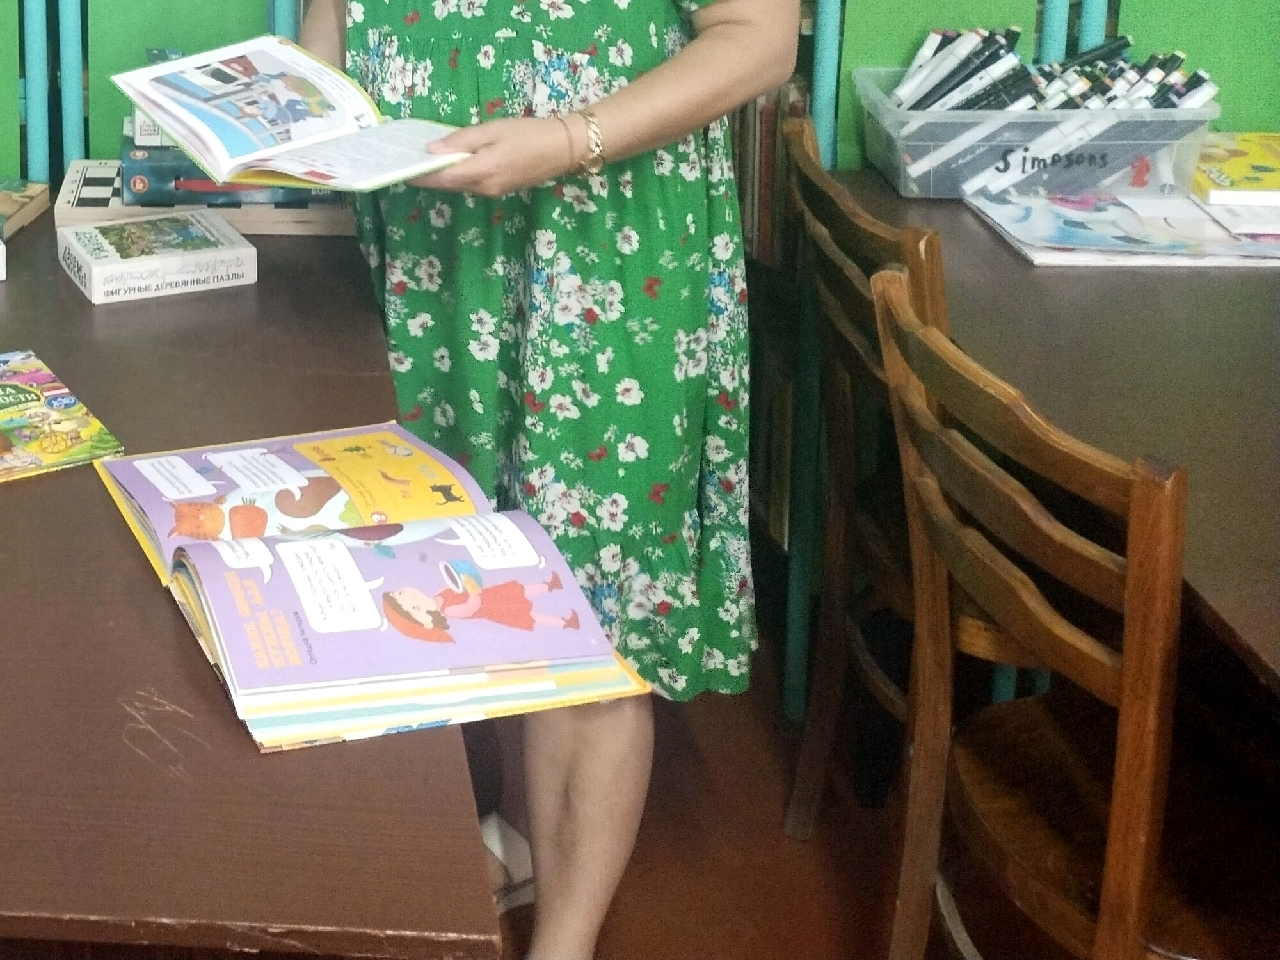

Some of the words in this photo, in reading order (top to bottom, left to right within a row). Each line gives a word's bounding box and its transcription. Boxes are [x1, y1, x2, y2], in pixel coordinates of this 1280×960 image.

[103, 283, 153, 298] ФИГУРНЫЕ
[154, 276, 211, 293] ДЕРЕВЯННЫЕ
[212, 272, 245, 285] ПАЗЛЫ
